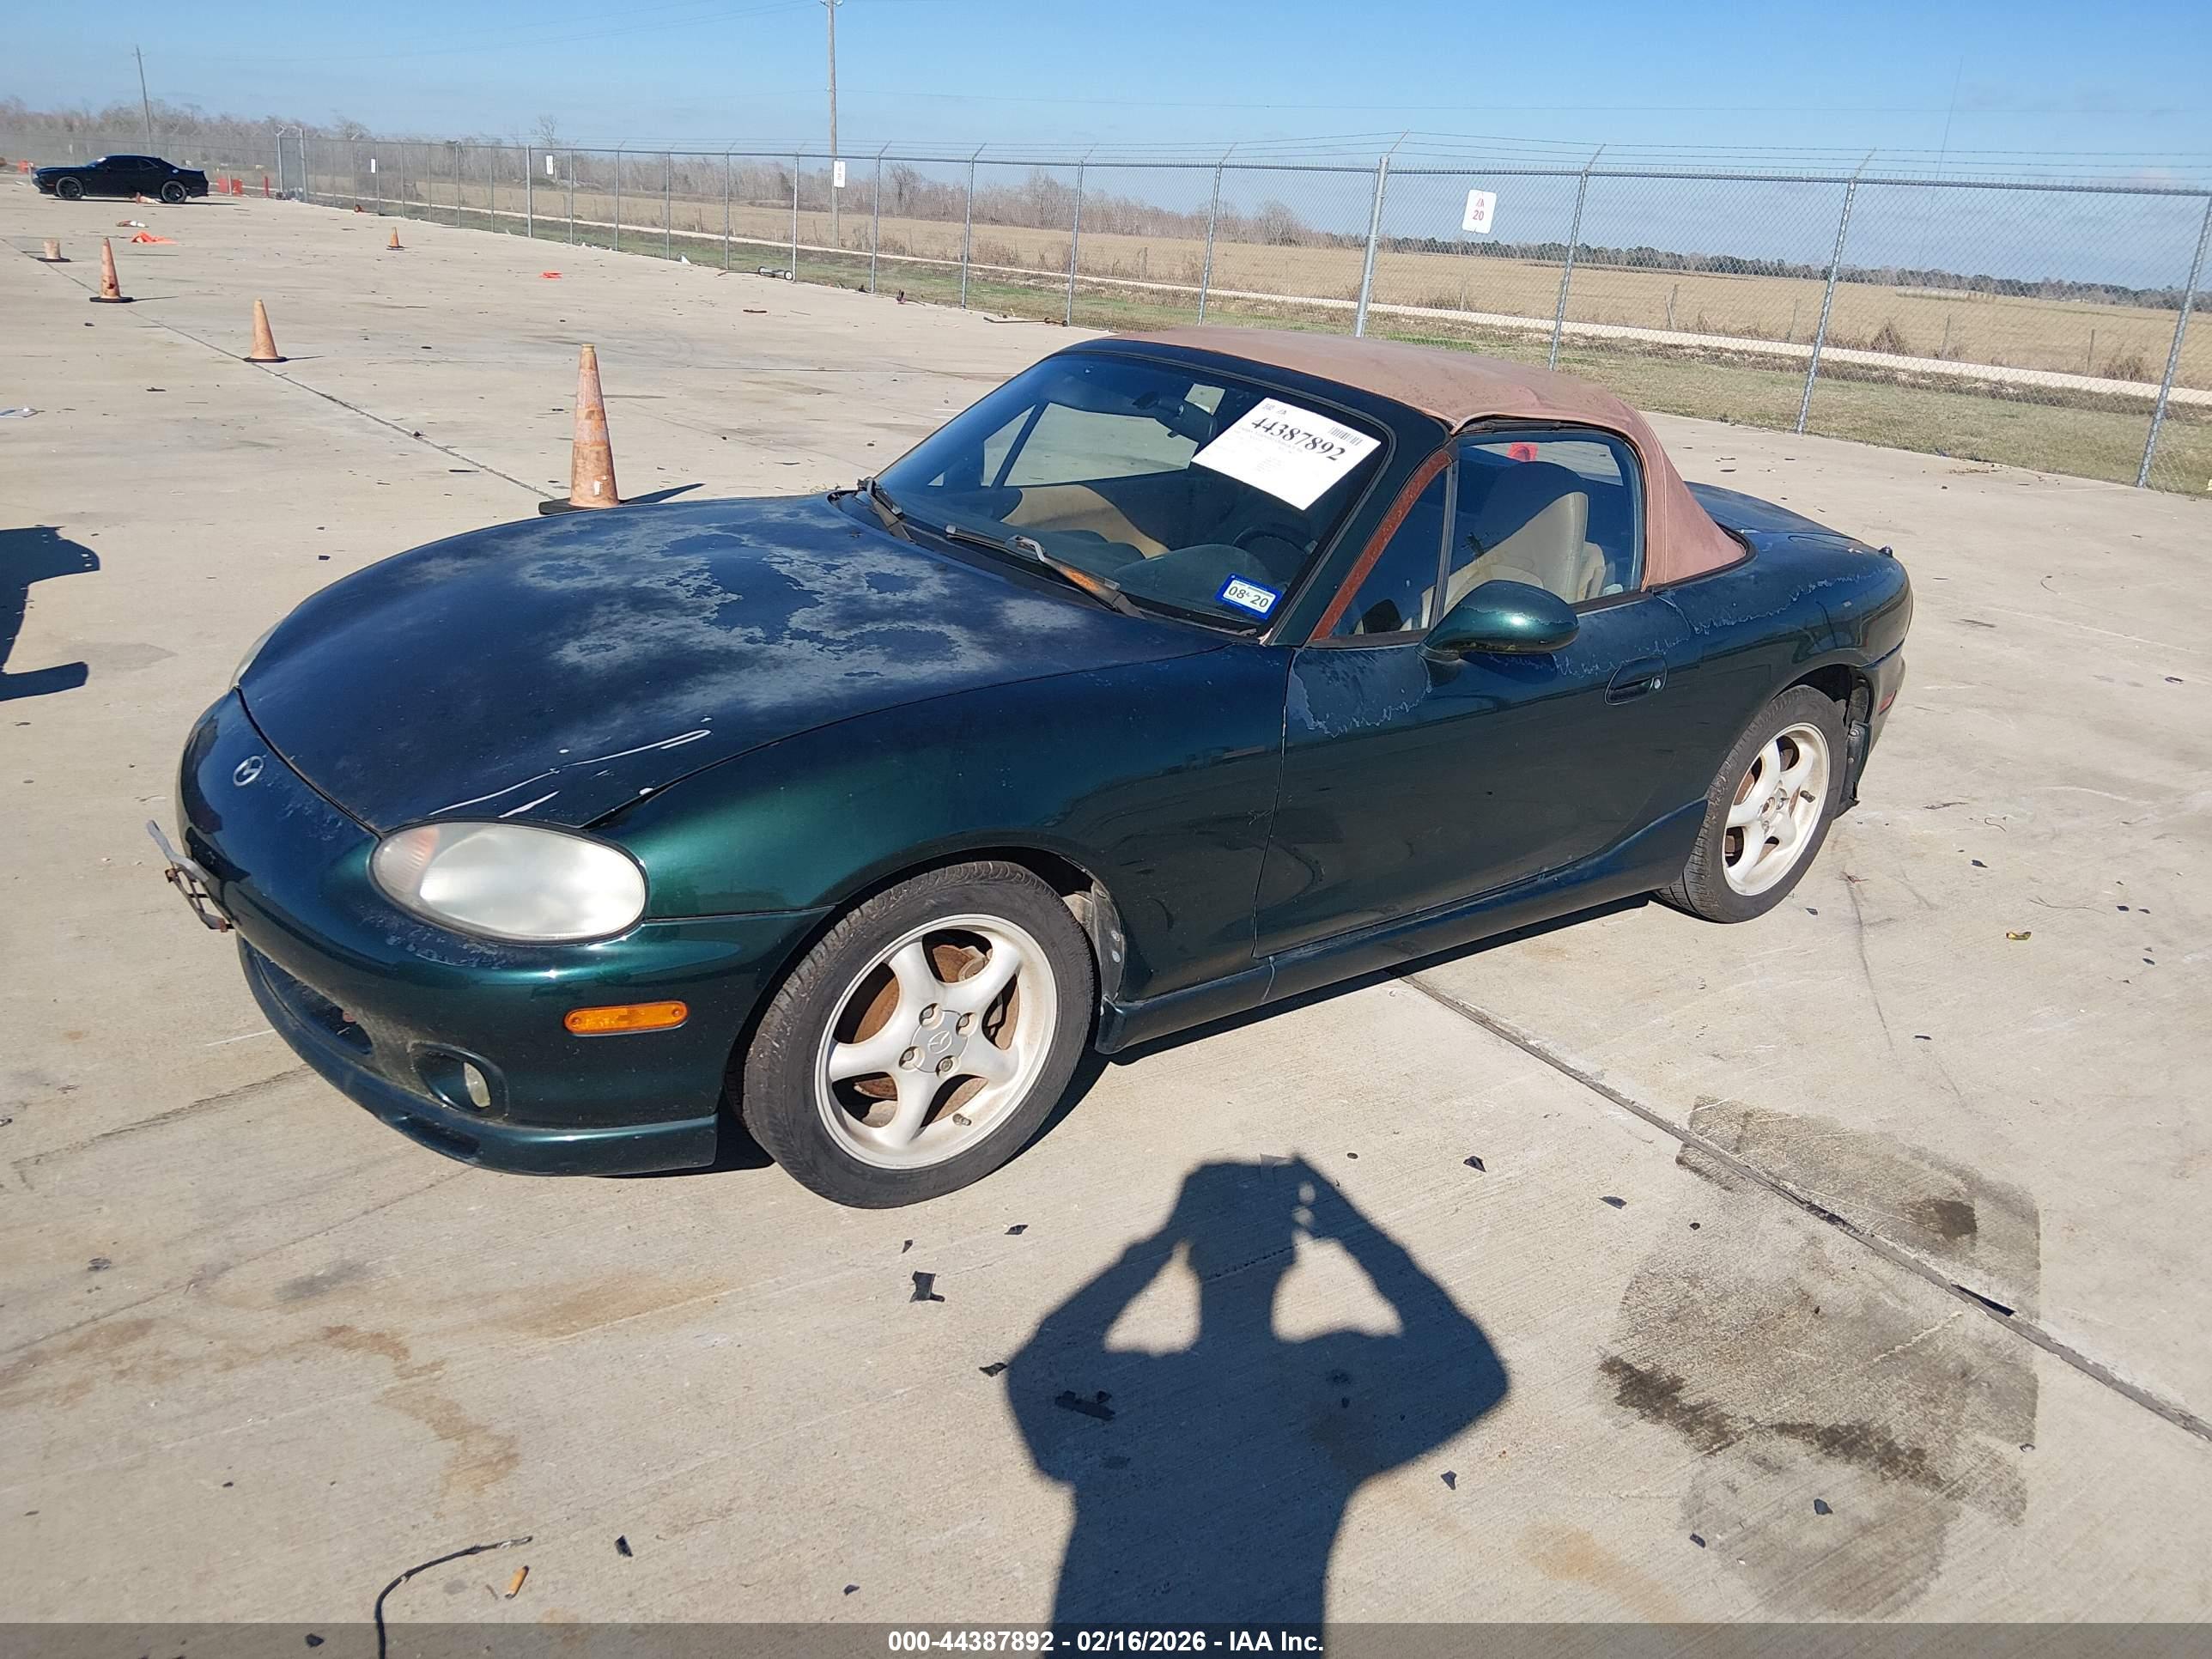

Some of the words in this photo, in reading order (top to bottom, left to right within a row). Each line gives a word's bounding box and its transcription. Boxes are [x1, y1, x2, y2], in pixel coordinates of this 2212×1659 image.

[1472, 210, 1485, 221] 20
[1252, 417, 1346, 461] 44387892
[1228, 586, 1246, 599] 08
[1250, 594, 1269, 608] 20
